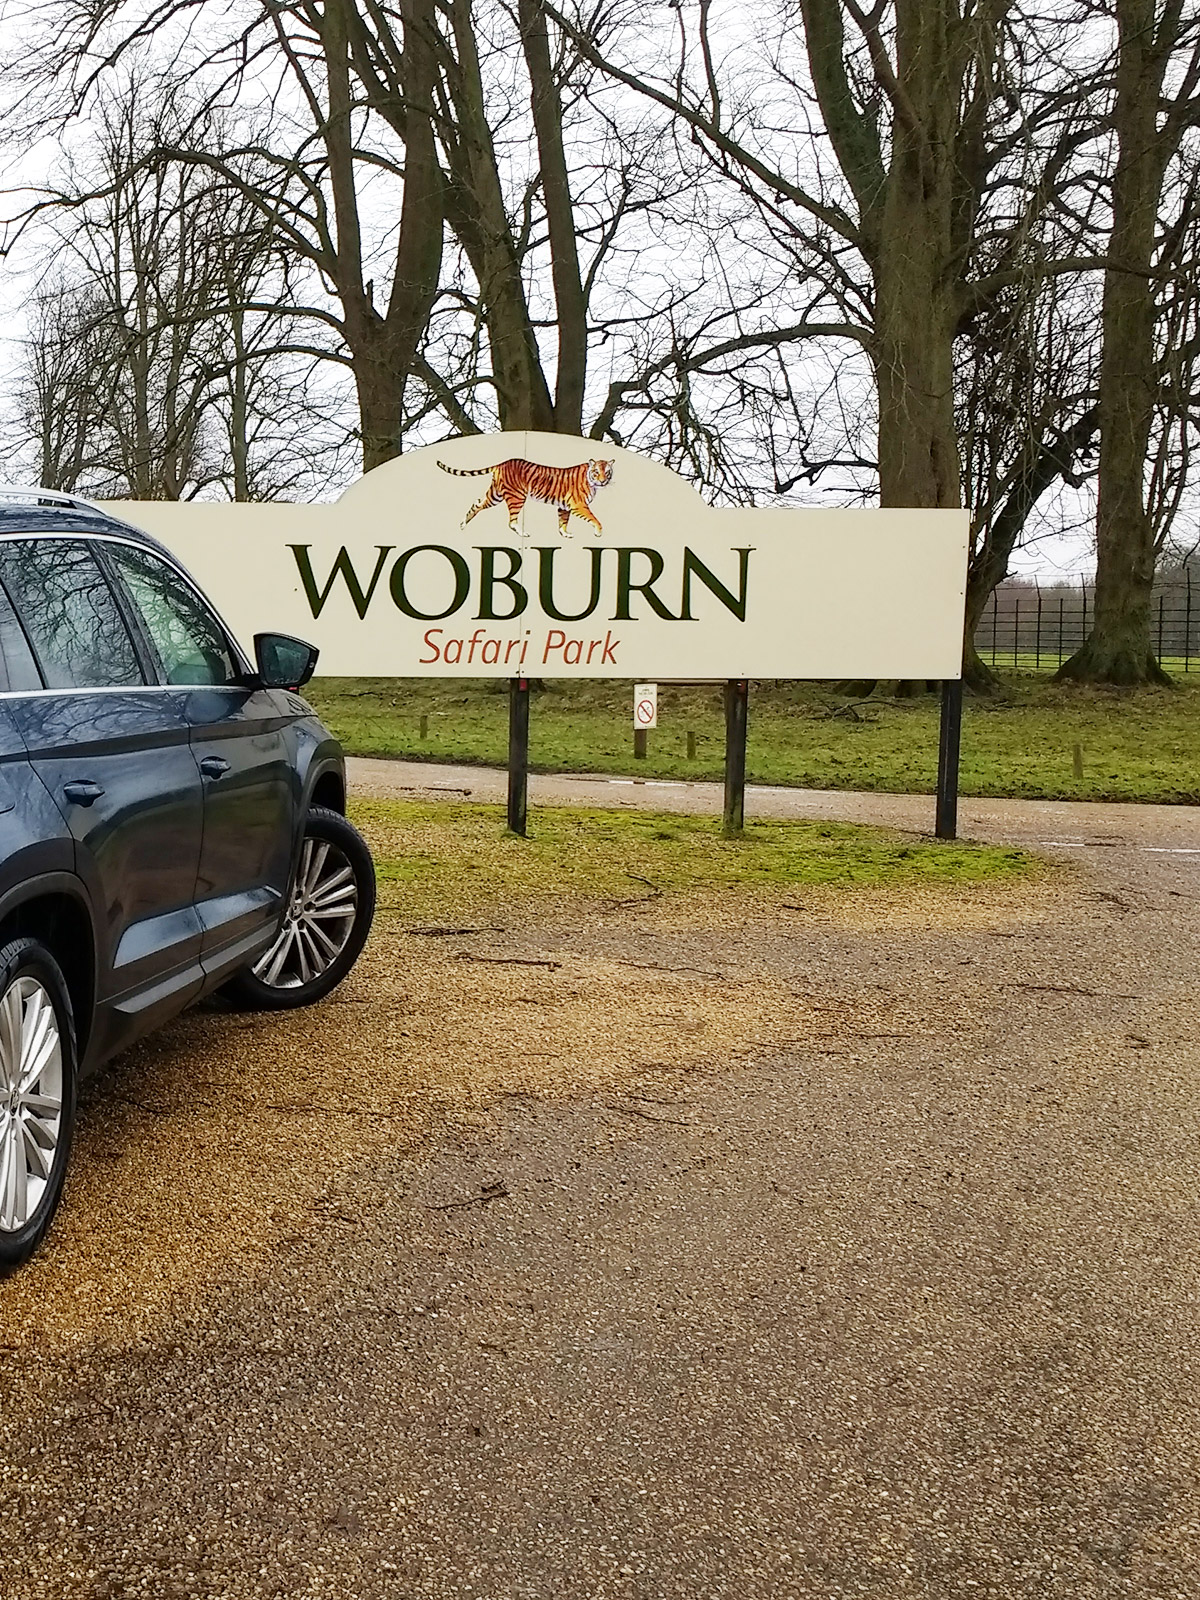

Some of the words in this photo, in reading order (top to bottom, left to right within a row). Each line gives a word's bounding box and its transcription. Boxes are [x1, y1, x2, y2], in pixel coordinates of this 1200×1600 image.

[285, 544, 757, 623] WOBURN
[419, 629, 531, 665] Safari
[542, 630, 621, 665] Park
